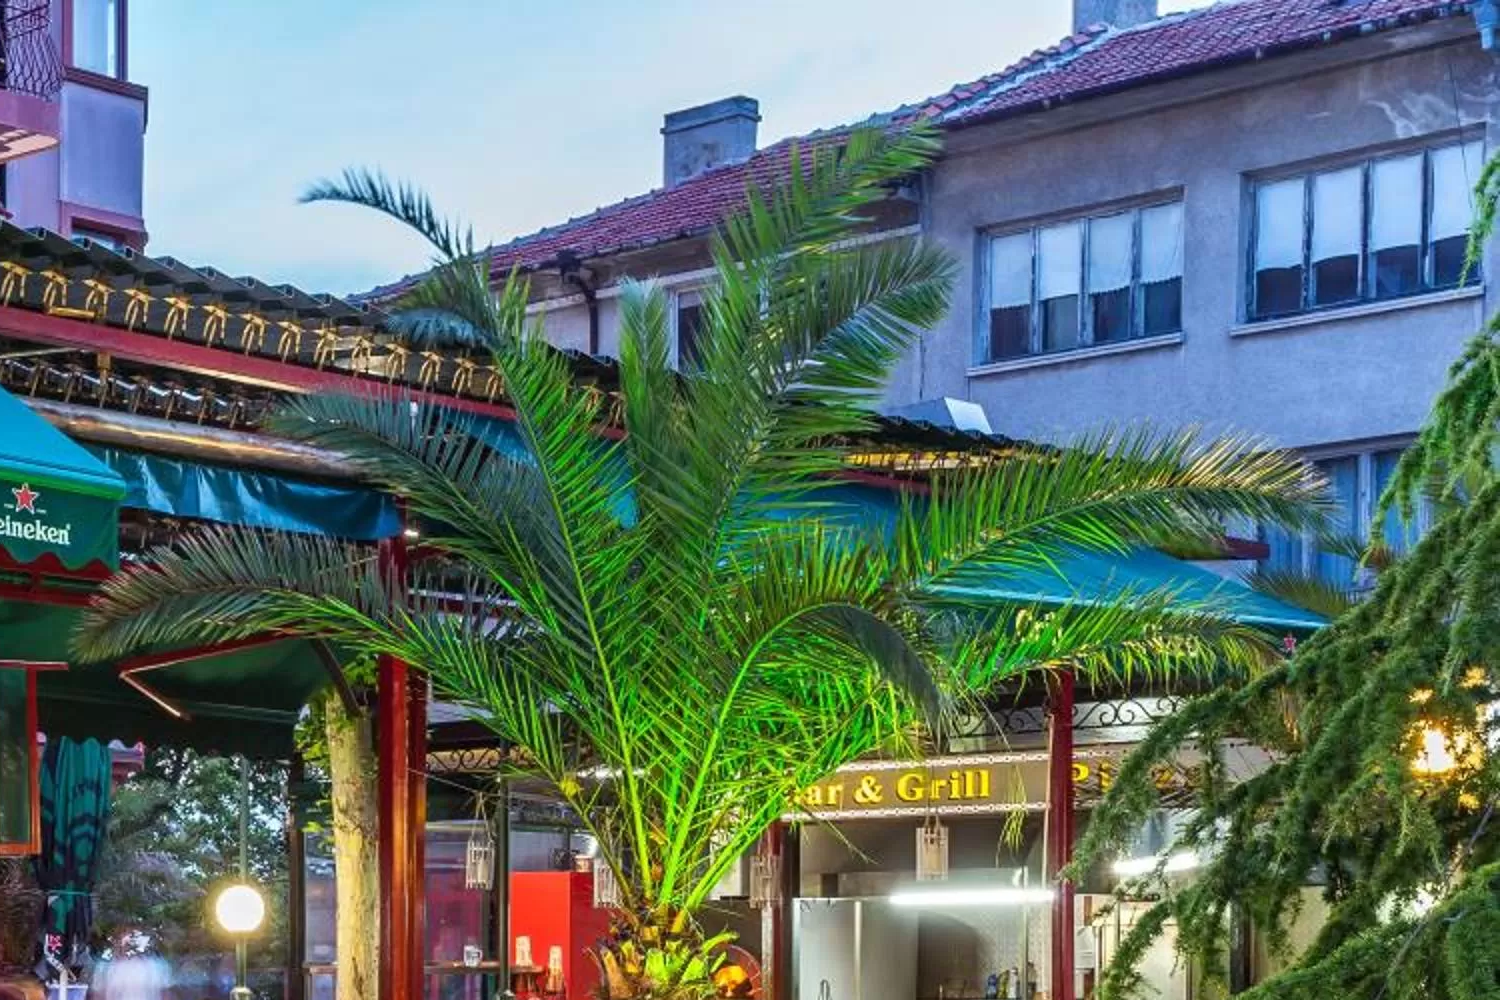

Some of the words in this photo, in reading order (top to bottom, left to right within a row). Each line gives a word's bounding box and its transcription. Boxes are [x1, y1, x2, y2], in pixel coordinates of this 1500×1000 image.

[785, 780, 844, 806] ar
[854, 775, 884, 804] &
[897, 769, 991, 802] Grill
